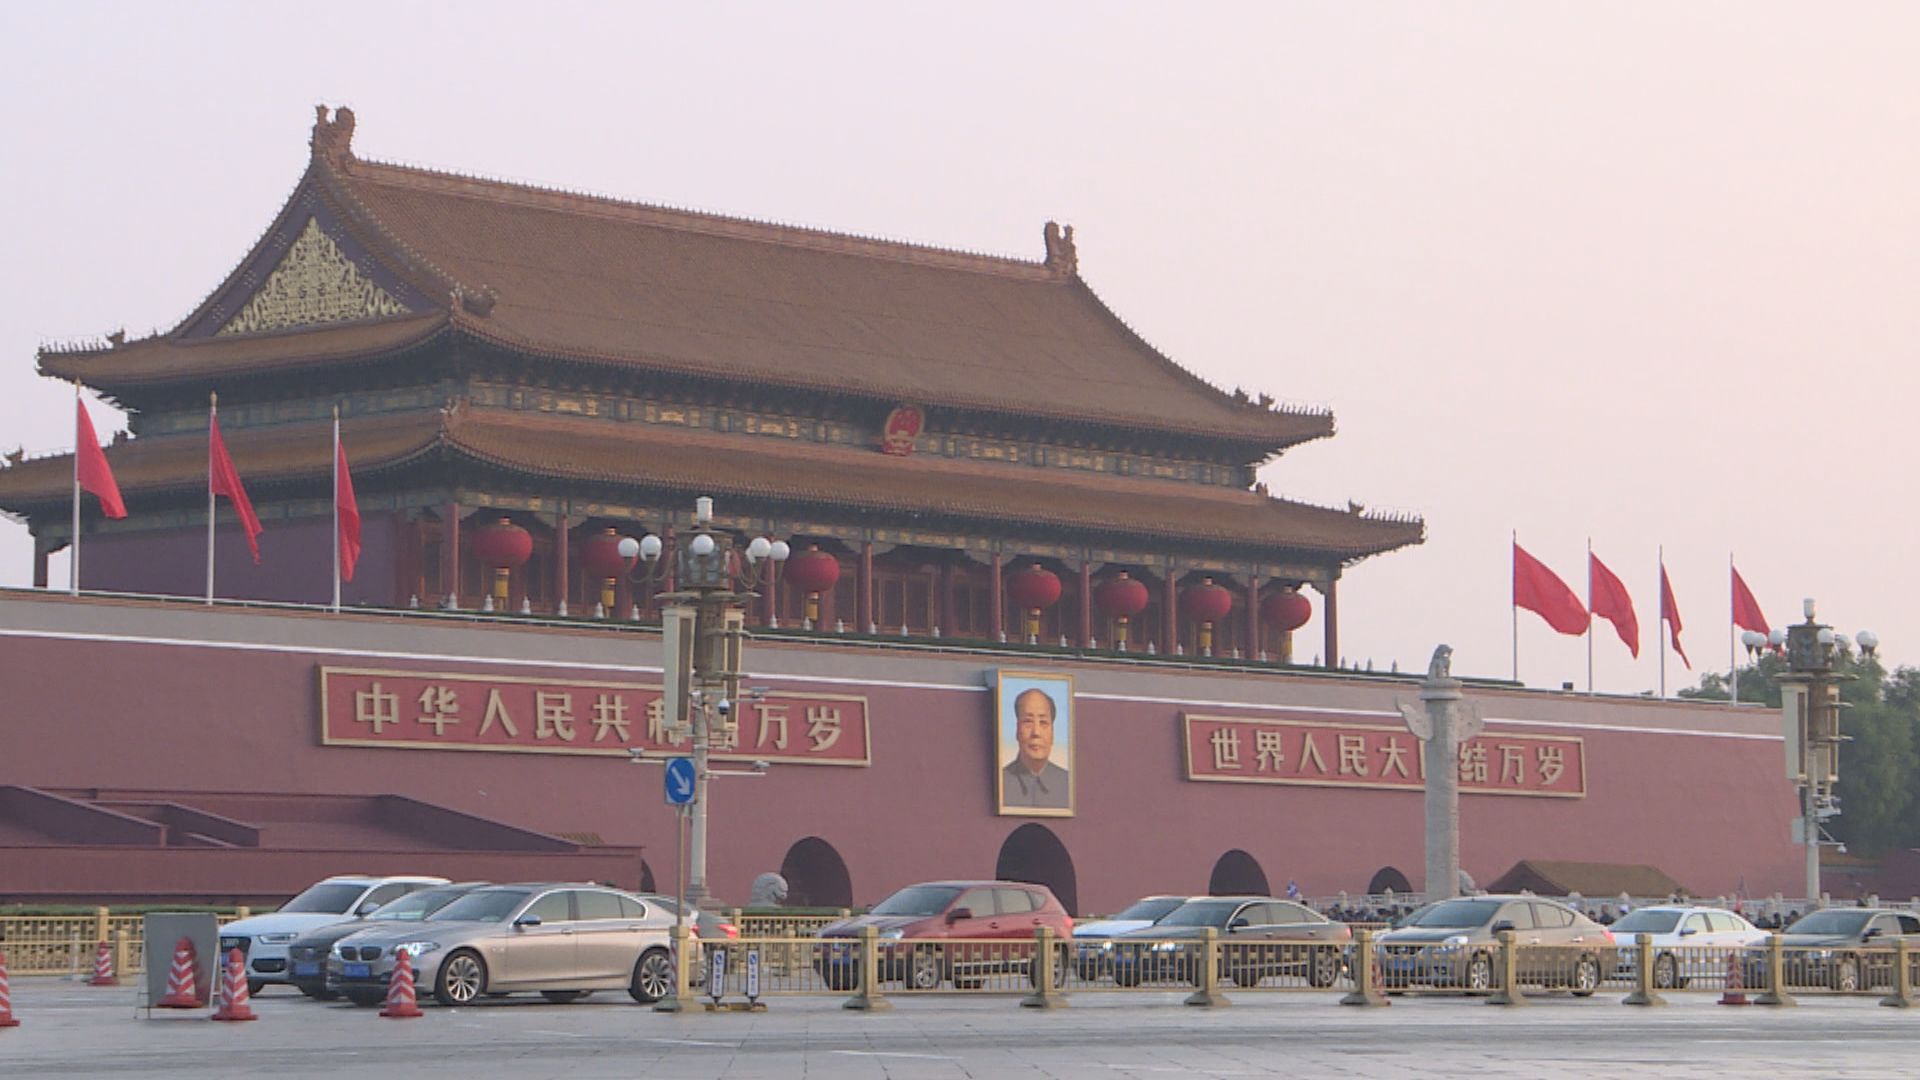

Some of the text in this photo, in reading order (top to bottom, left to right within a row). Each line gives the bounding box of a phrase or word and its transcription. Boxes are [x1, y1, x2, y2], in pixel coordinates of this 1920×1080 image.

[1210, 728, 1565, 785] 世界人民大结万岁
